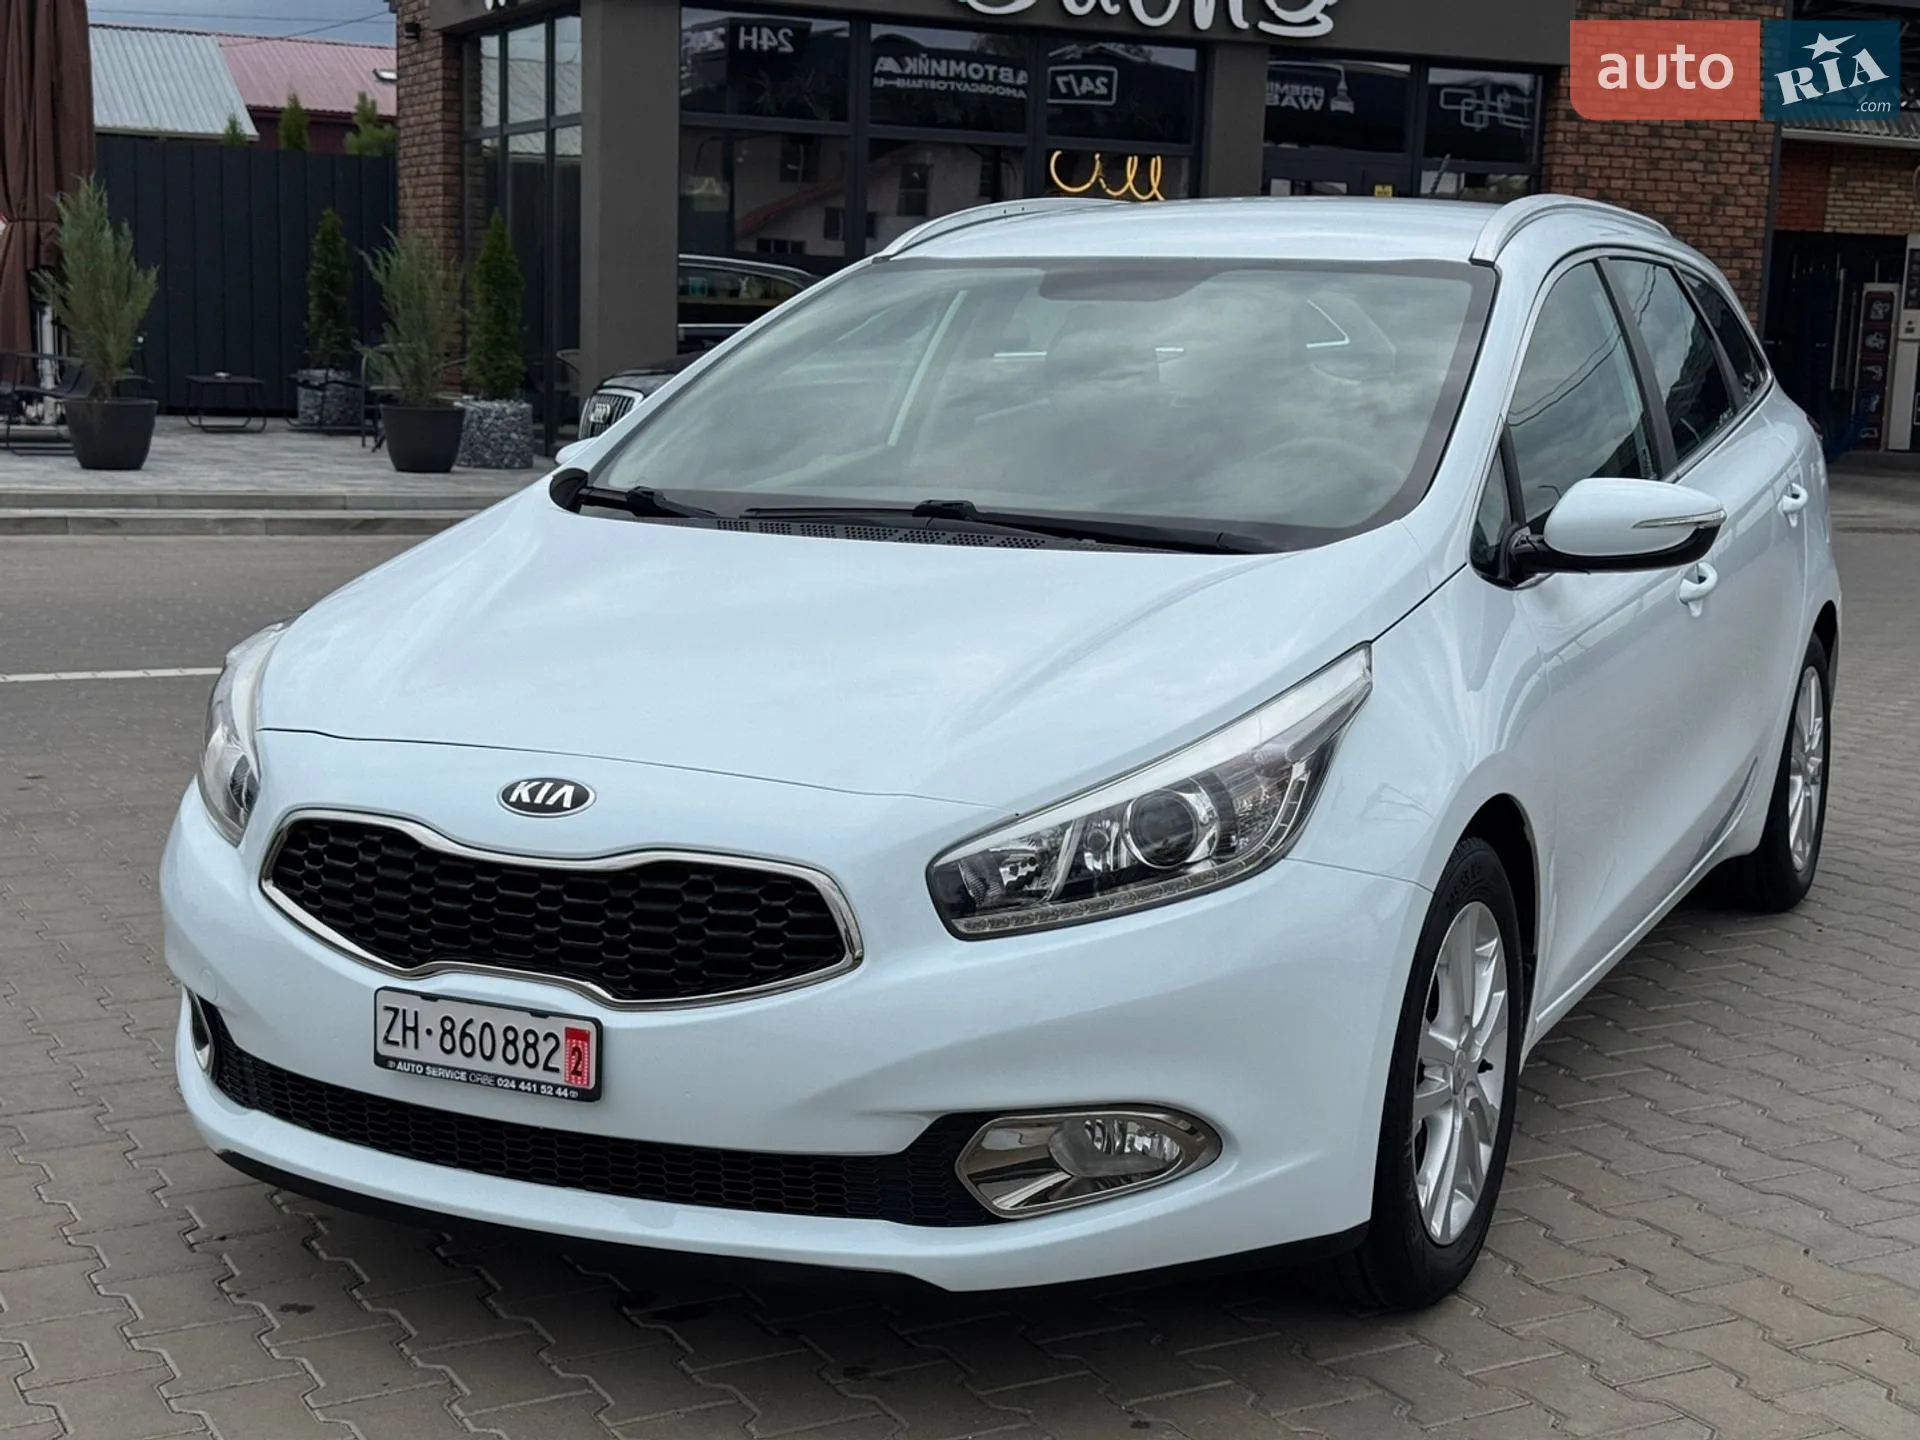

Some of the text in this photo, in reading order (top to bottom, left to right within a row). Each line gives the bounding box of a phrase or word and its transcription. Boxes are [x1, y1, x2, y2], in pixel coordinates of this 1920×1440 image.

[509, 781, 575, 809] KIA
[570, 1046, 583, 1077] 2
[396, 1061, 424, 1074] AUTO
[425, 1065, 467, 1081] SERVICE
[497, 1077, 516, 1089] 024
[519, 1081, 538, 1093] 441
[540, 1085, 553, 1096] 52
[555, 1088, 569, 1098] 44
